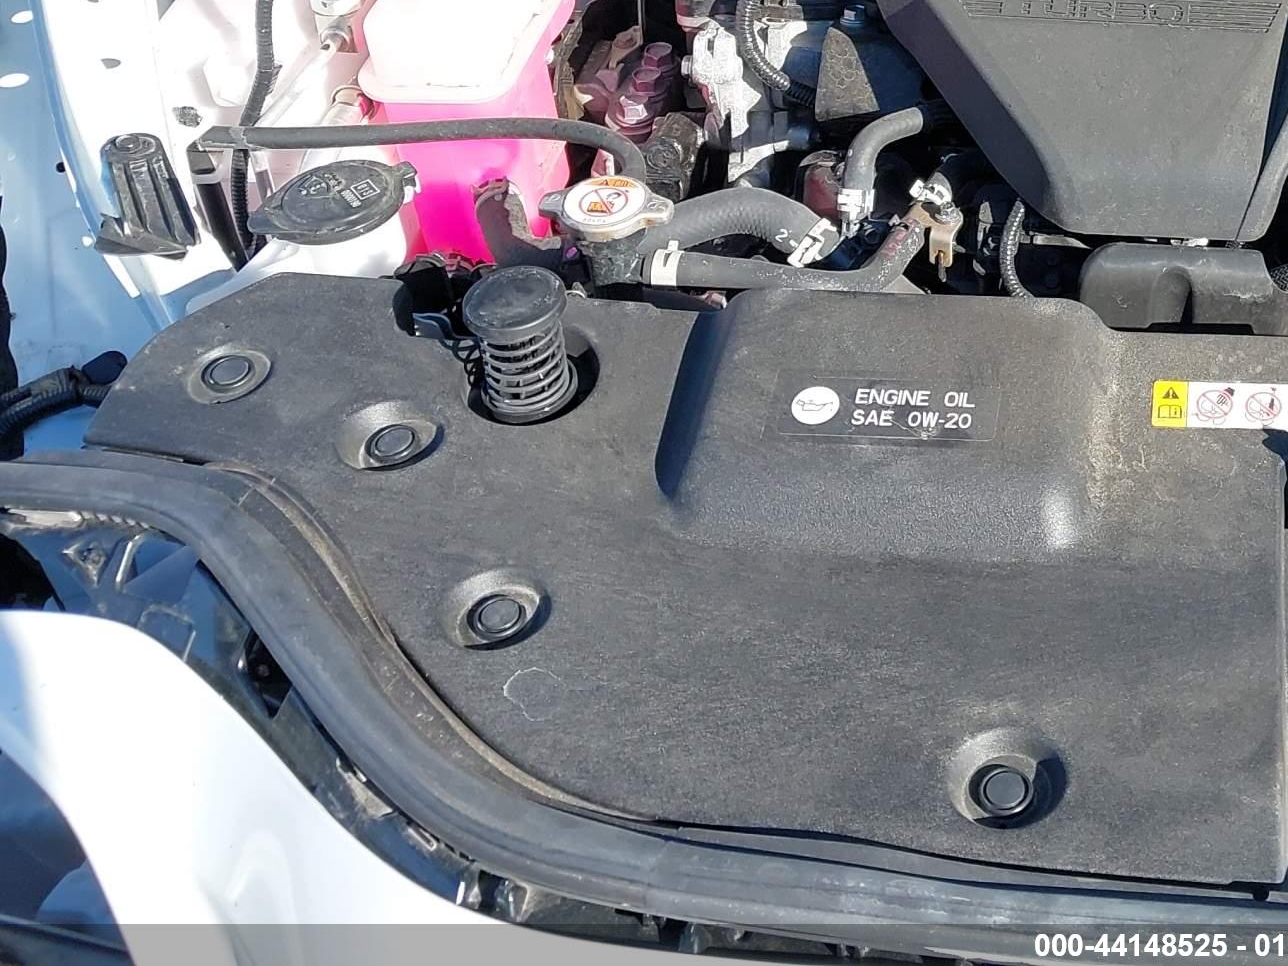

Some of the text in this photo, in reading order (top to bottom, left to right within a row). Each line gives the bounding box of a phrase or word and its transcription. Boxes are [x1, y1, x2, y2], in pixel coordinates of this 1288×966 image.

[855, 388, 976, 408] ENGINE OIL
[851, 409, 972, 429] SAE 0W-20
